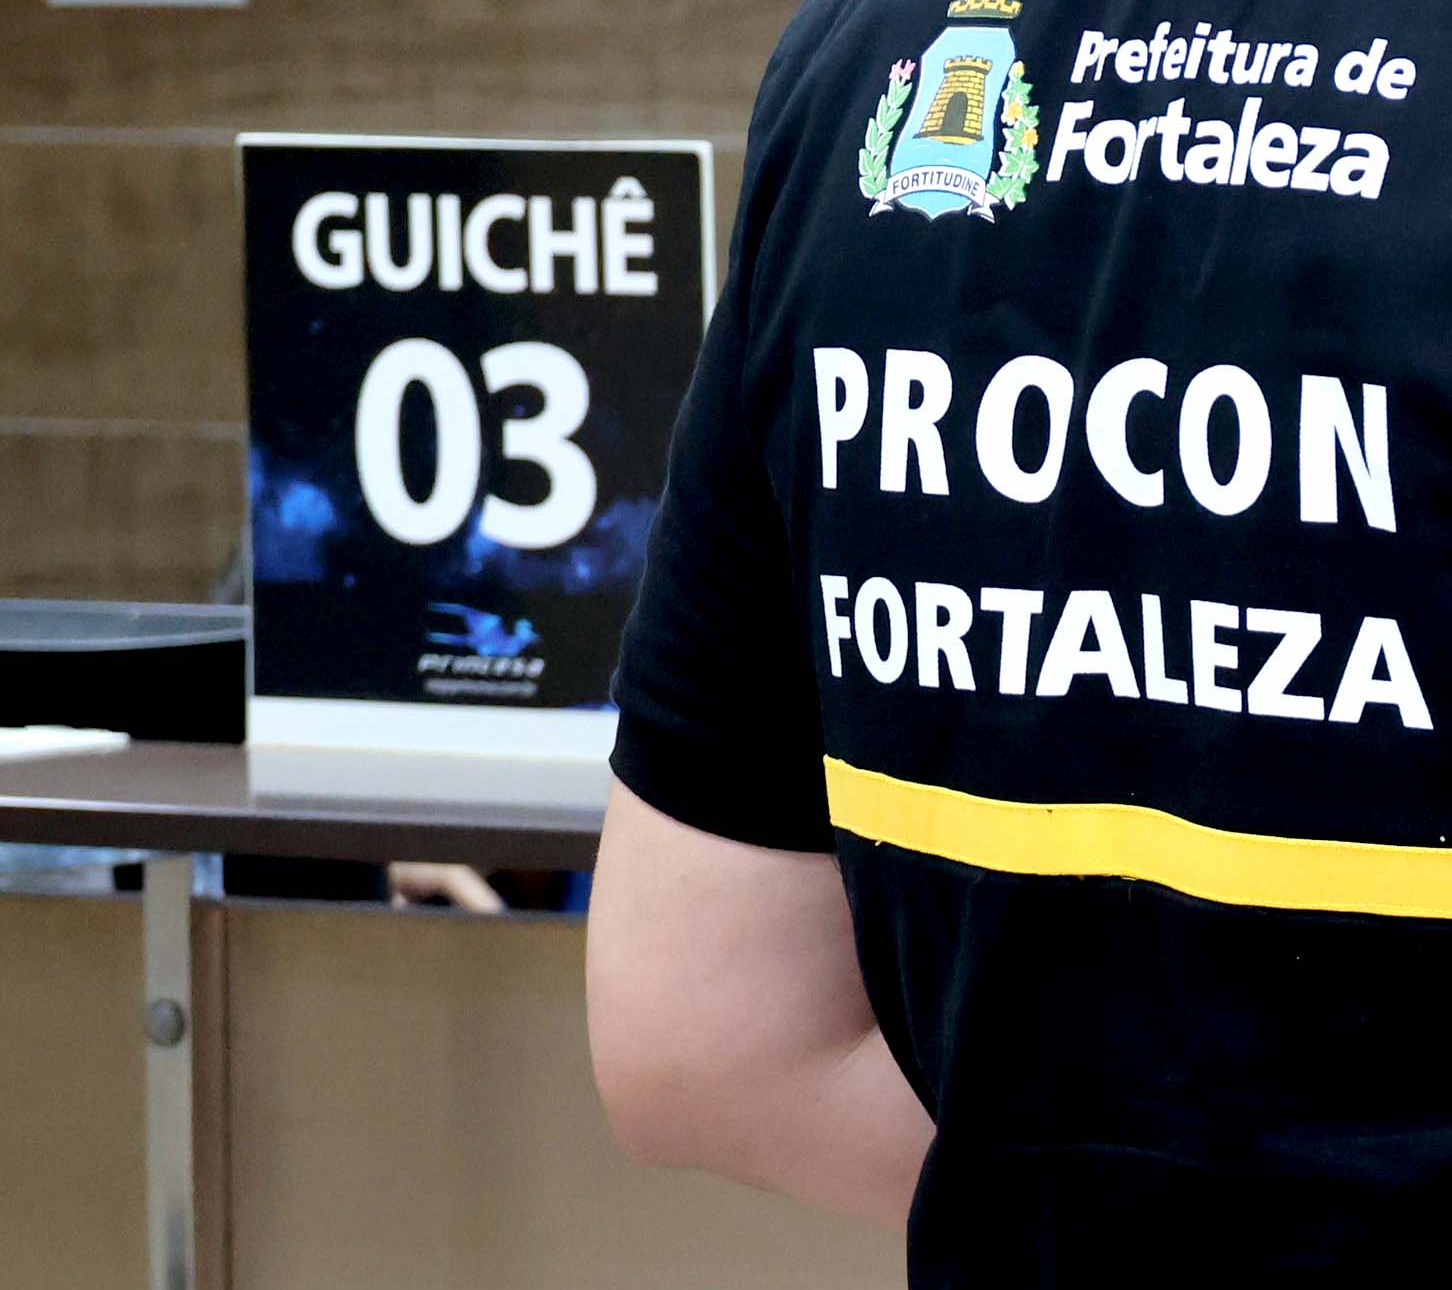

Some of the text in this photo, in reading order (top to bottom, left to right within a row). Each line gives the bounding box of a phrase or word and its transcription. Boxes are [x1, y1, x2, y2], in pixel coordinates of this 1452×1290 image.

[1069, 20, 1418, 100] Prefeitura de
[891, 170, 981, 196] FORTITUDINE
[1045, 97, 1391, 200] Fortaleza
[292, 175, 659, 297] GUICHÊ
[354, 337, 597, 550] 03
[813, 346, 1398, 534] PROCON
[819, 573, 1435, 731] FORTALEZA
